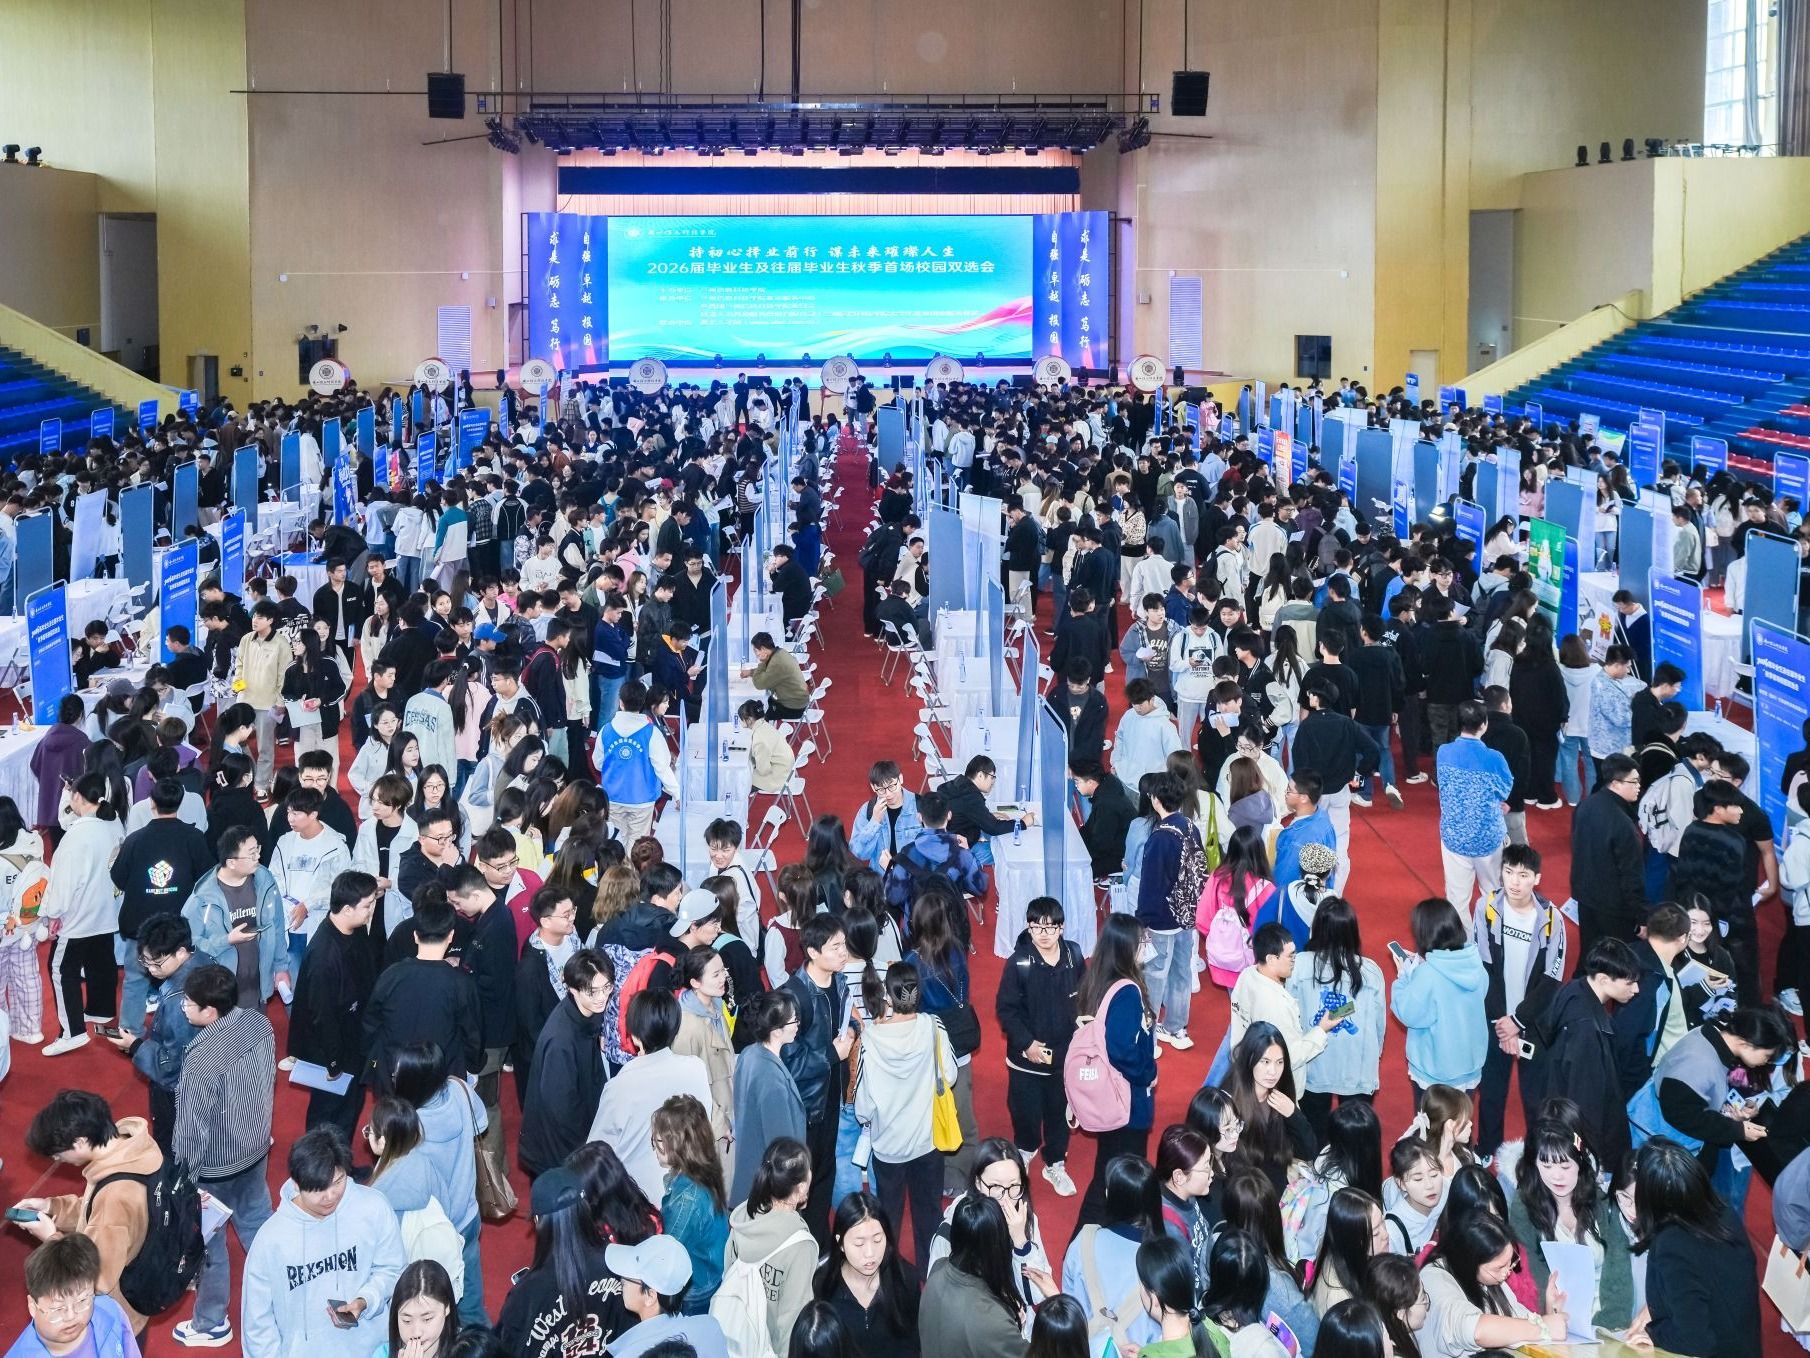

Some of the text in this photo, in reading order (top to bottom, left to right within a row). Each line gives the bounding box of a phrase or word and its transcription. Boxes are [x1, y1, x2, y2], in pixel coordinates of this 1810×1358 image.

[688, 245, 955, 258] 持初心择业前行 谋未来璀璨人生
[647, 261, 995, 275] 2026届毕业生及往届毕业生秋季首场校园双选会
[526, 1294, 567, 1347] West
